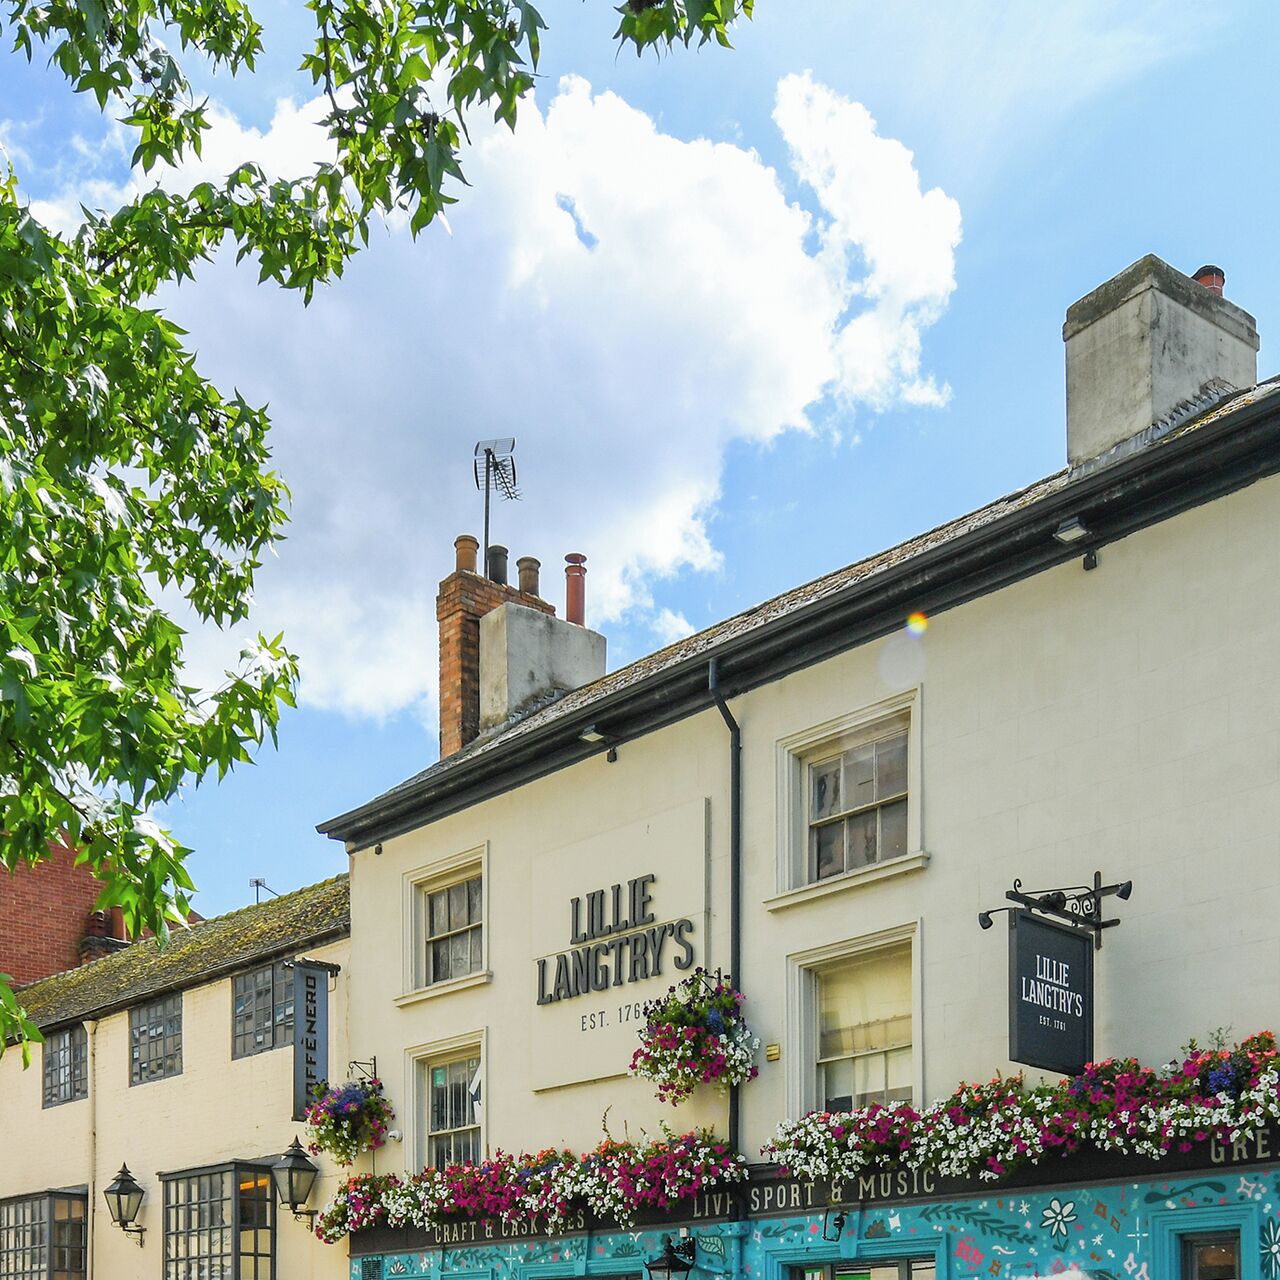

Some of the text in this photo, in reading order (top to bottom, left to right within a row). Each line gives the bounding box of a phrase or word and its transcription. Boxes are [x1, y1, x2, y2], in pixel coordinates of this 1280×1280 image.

[570, 873, 655, 945] LILLIE
[537, 919, 695, 1006] LANGTRY'S
[1036, 954, 1069, 988] LILLIE
[581, 1001, 648, 1032] EST. 176
[1022, 976, 1083, 1018] LANGTRY'S
[301, 975, 317, 1106] AFFÈ NERO
[1039, 1015, 1066, 1032] EST. 1761
[751, 1182, 815, 1211] SPORT
[831, 1179, 842, 1202] &
[858, 1168, 935, 1200] MUSIC
[434, 1220, 477, 1244] CRAFT
[485, 1213, 493, 1238] &
[501, 1207, 538, 1238] CASK
